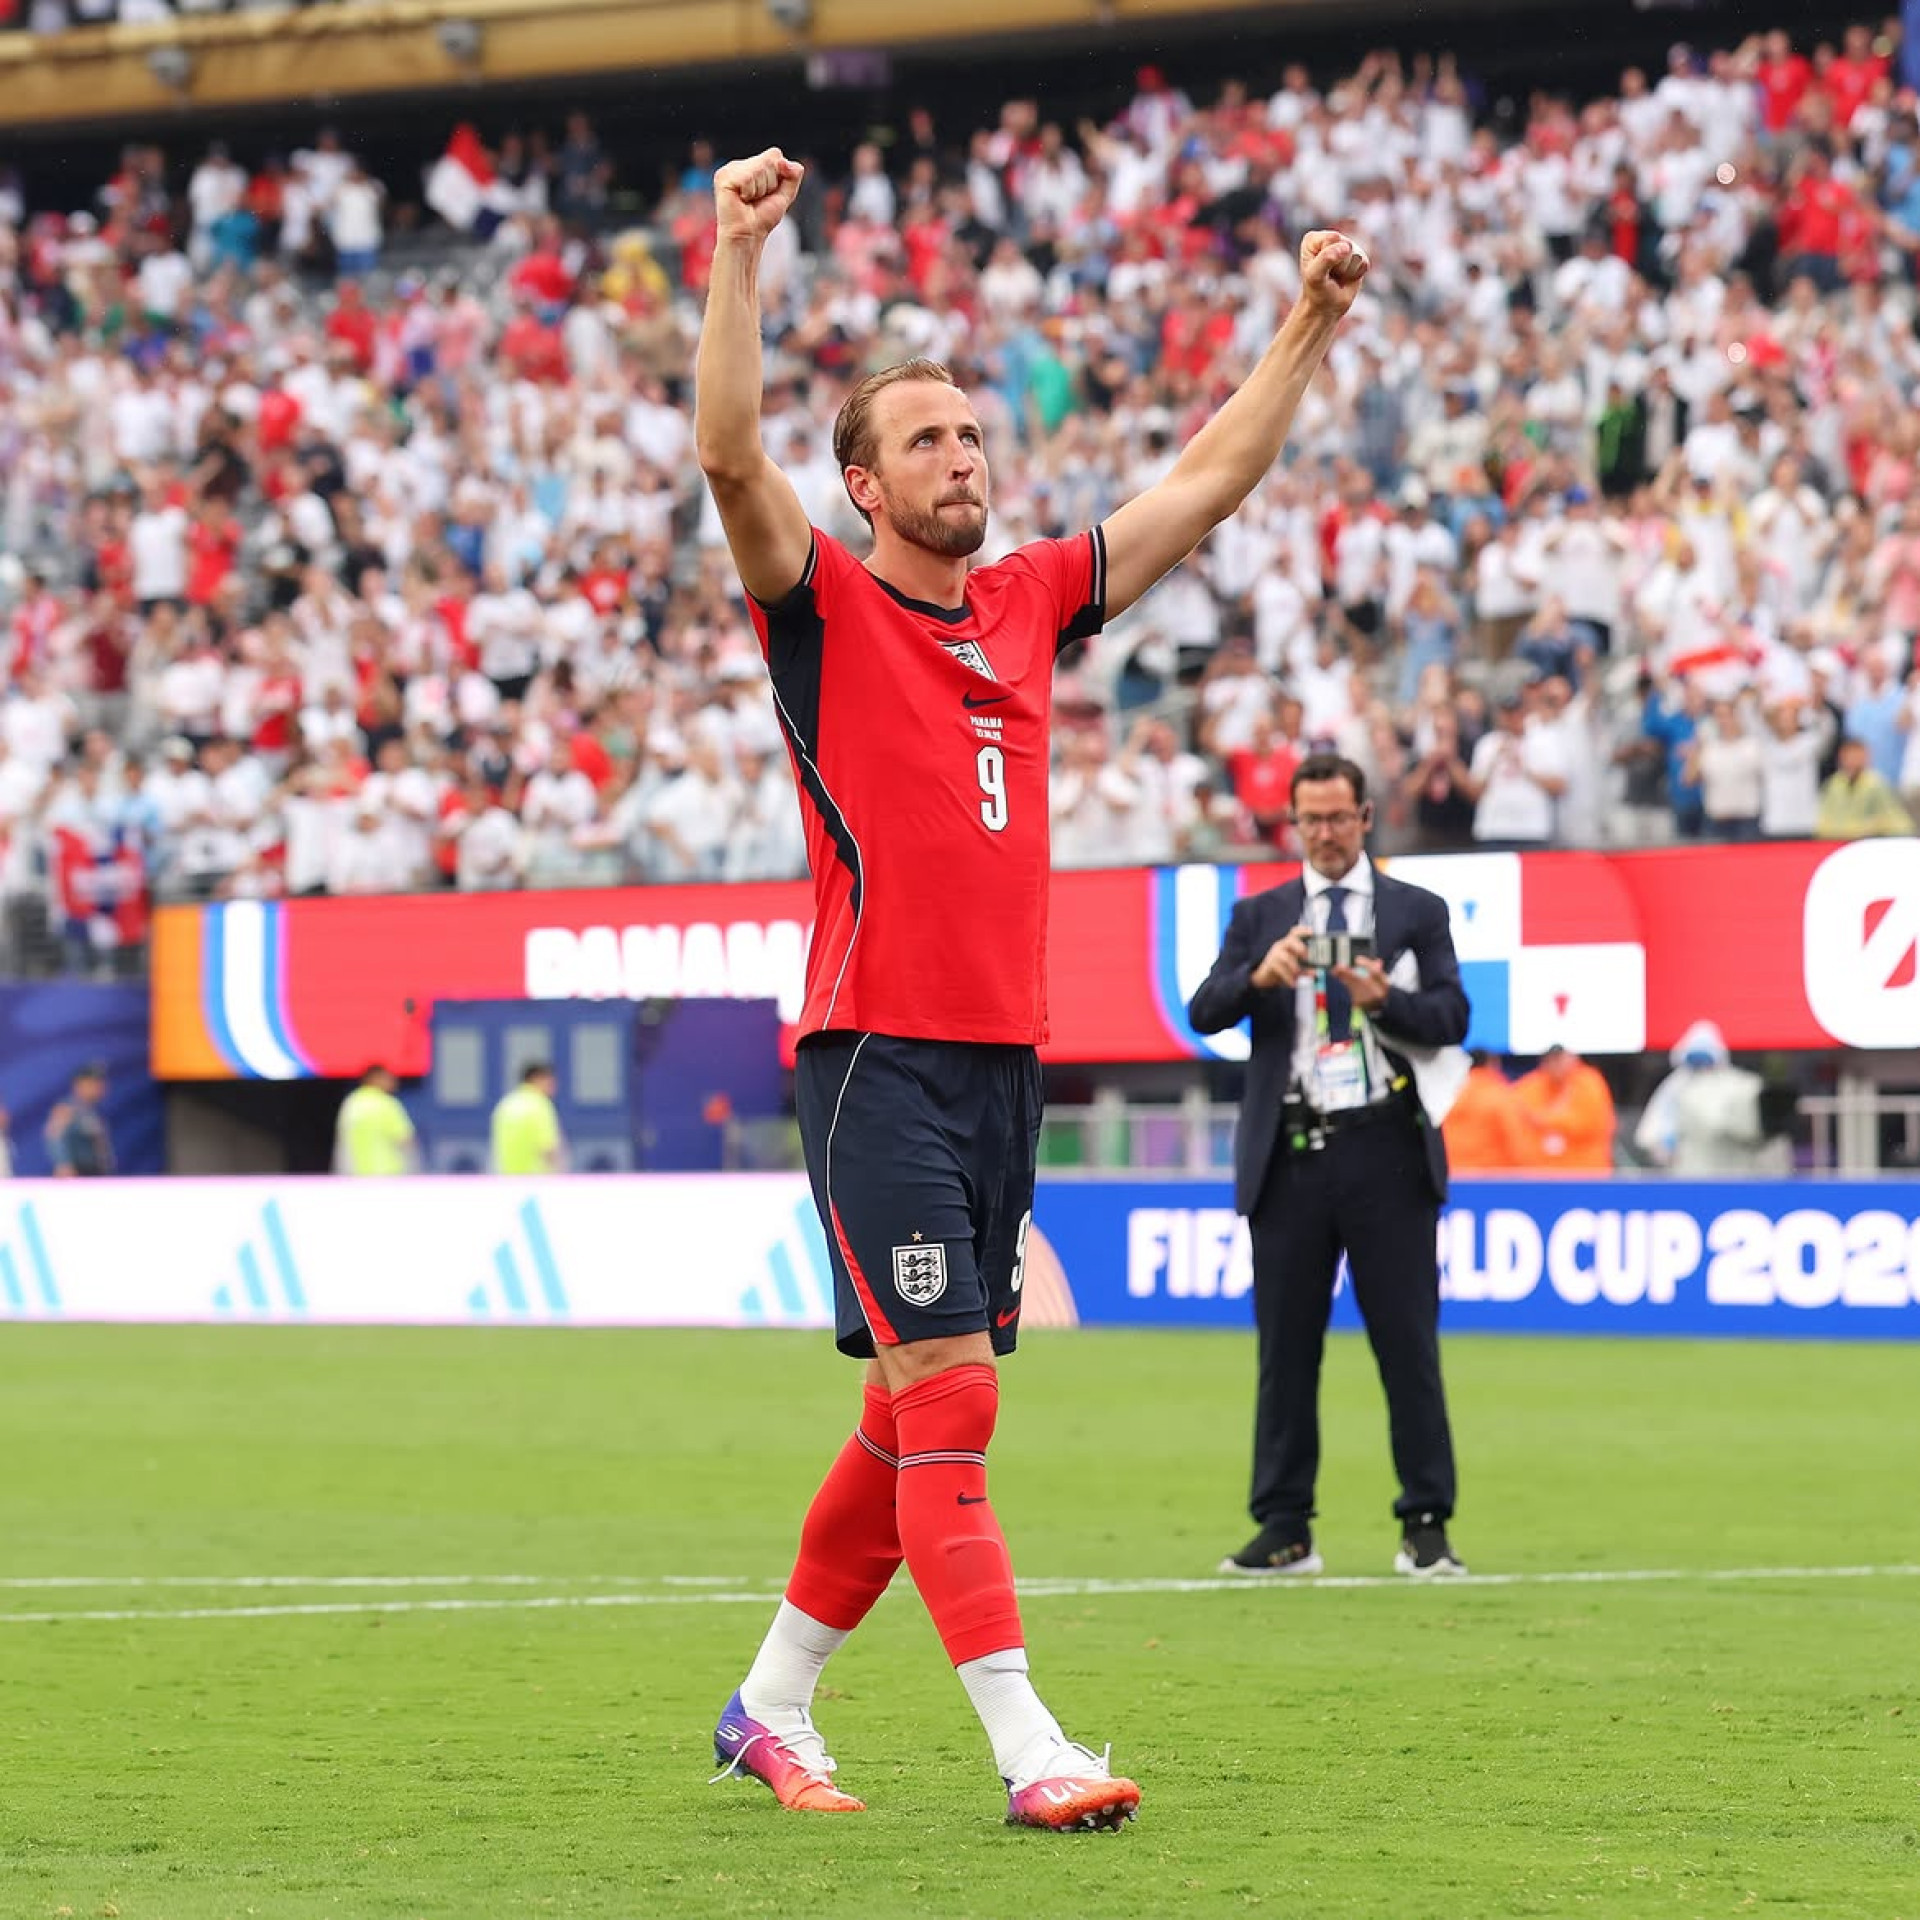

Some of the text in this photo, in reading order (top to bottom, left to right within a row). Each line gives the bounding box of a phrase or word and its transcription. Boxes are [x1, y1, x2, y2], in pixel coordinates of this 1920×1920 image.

[977, 745, 1009, 832] 9
[525, 919, 815, 1023] PANAM
[1548, 1207, 1702, 1305] CUP
[1706, 1208, 1920, 1308] 202
